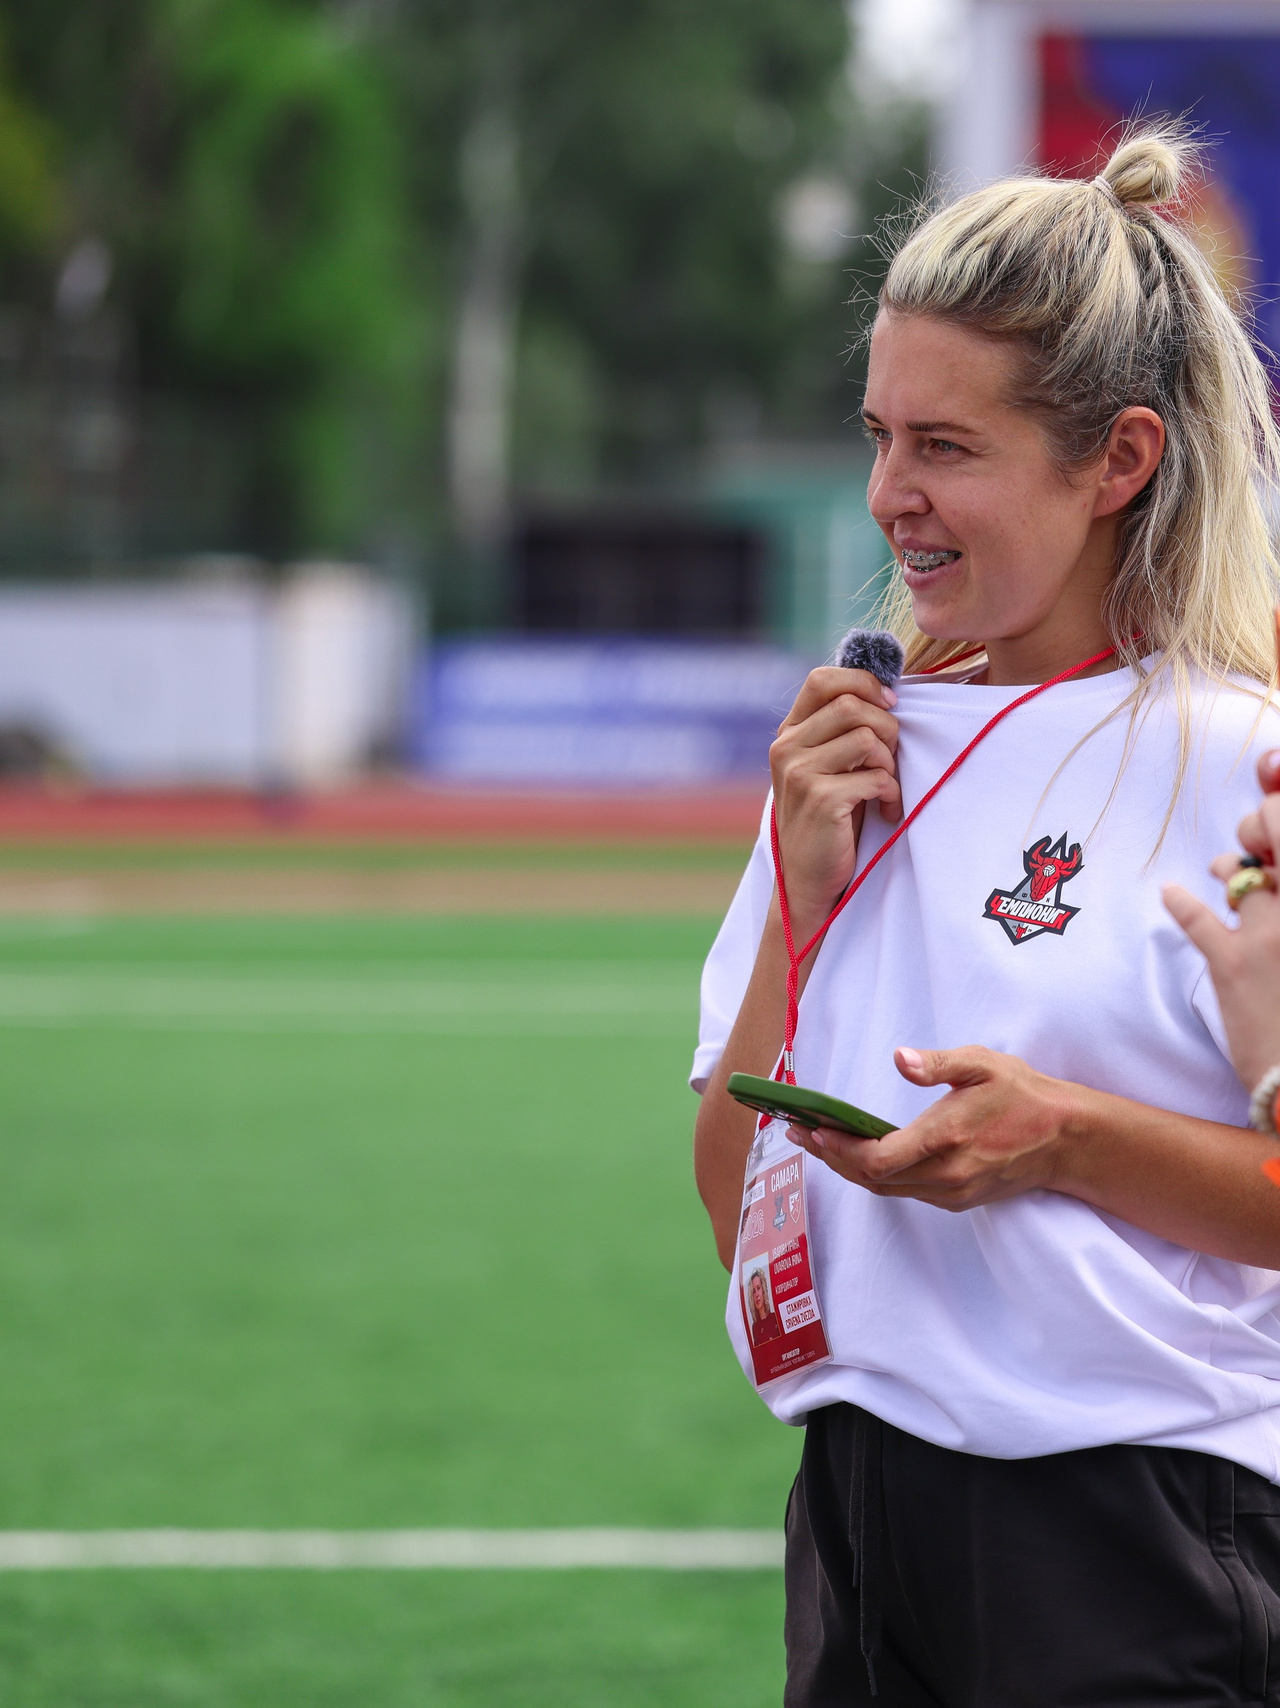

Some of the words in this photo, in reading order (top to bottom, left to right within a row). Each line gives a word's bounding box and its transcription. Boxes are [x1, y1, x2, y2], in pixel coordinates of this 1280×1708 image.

[990, 895, 1071, 930] ЧЕМПИОНИК
[771, 1162, 799, 1192] САМАРА
[786, 1296, 812, 1314] СТАЖИРОВКА
